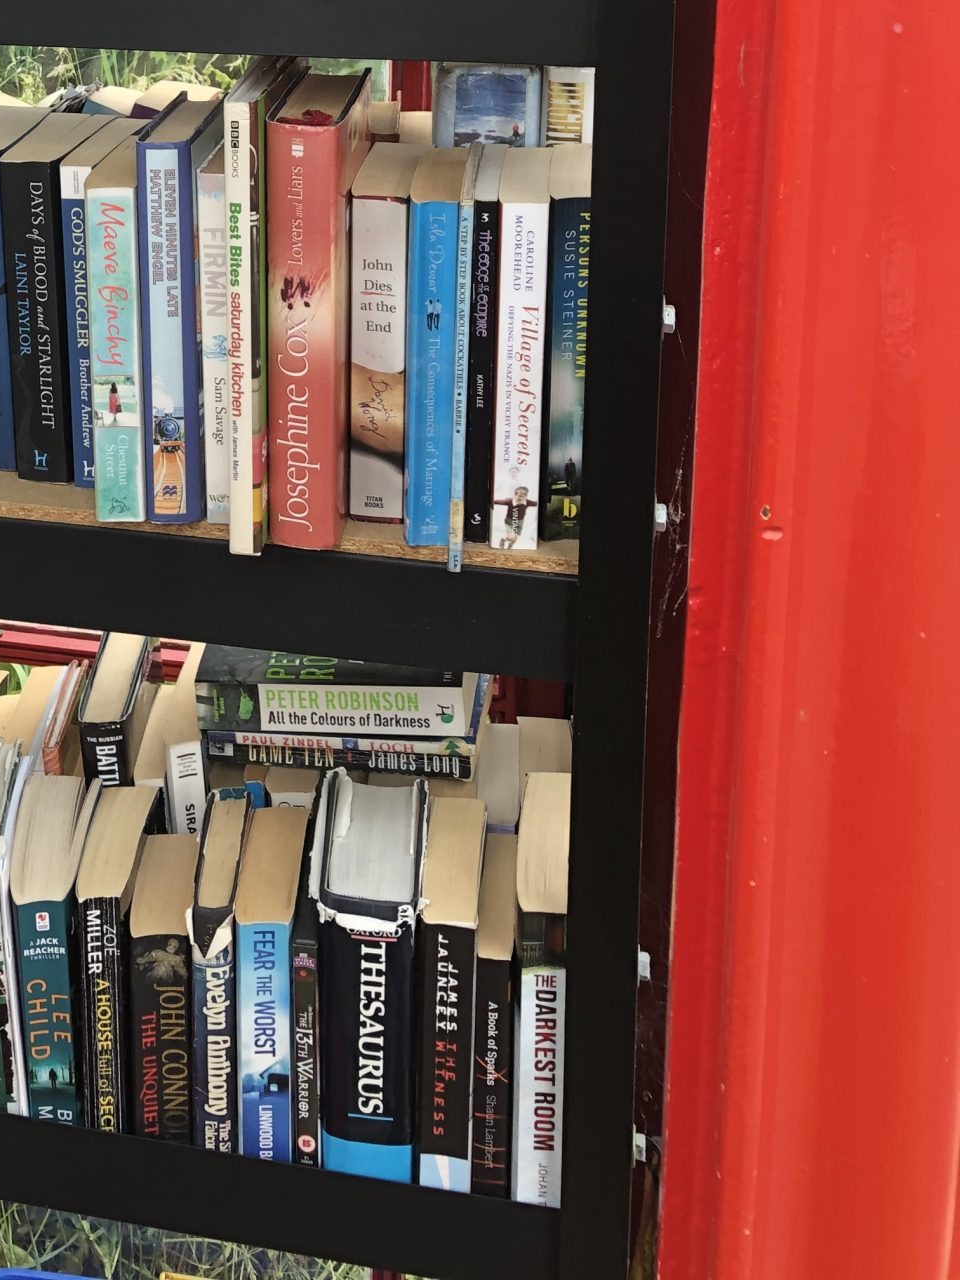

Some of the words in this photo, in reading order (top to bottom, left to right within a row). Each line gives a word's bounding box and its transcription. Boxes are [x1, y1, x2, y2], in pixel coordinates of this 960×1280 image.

[97, 201, 127, 275] Maeve
[512, 215, 524, 292] MOOREHEAD
[524, 229, 536, 294] CAROLINE
[362, 259, 393, 273] John
[96, 285, 129, 368] Binchy
[360, 301, 372, 313] at
[374, 300, 397, 313] the
[365, 321, 393, 334] End
[277, 316, 309, 377] Cox
[456, 339, 465, 390] COCKATIELS
[476, 374, 484, 394] KATHY
[476, 395, 484, 408] LEE
[277, 384, 321, 532] Josephine
[266, 688, 321, 711] PETER
[325, 691, 420, 712] ROBINSON
[268, 712, 284, 725] All
[286, 711, 306, 725] the
[309, 713, 350, 728] Colours
[352, 714, 371, 727] of
[374, 715, 431, 729] Darkness
[98, 734, 123, 742] RUSSIAN
[86, 909, 102, 975] MILLER
[252, 930, 276, 973] FEAR
[255, 976, 273, 998] THE
[534, 974, 556, 989] THE
[26, 979, 51, 1061] CHILD
[51, 993, 72, 1043] LEE
[254, 1000, 277, 1058] WORST
[358, 942, 386, 1116] THESAURUS
[533, 990, 557, 1088] DARKEST
[533, 1093, 556, 1153] ROOM
